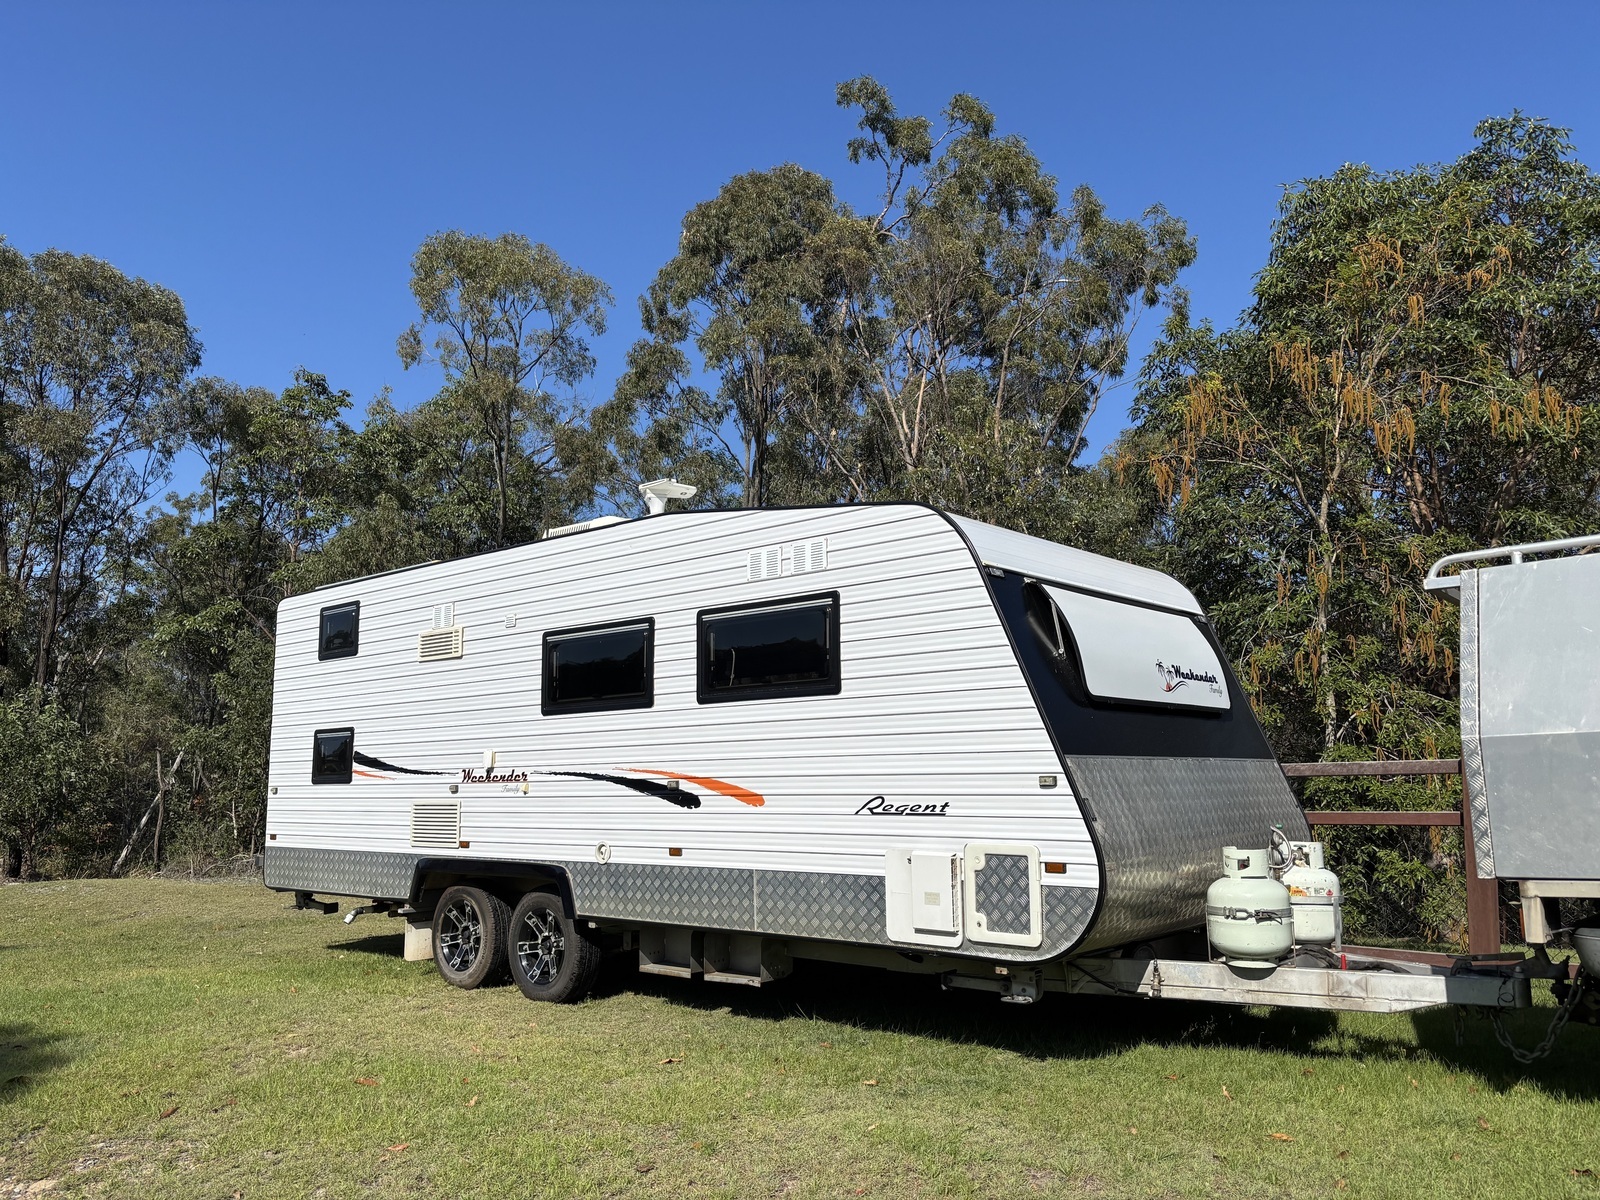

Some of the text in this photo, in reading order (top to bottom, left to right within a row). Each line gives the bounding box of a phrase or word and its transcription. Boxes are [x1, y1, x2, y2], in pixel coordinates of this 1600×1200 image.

[1171, 664, 1218, 684] Weekender
[461, 768, 529, 784] Weekender
[854, 795, 951, 816] Regent
